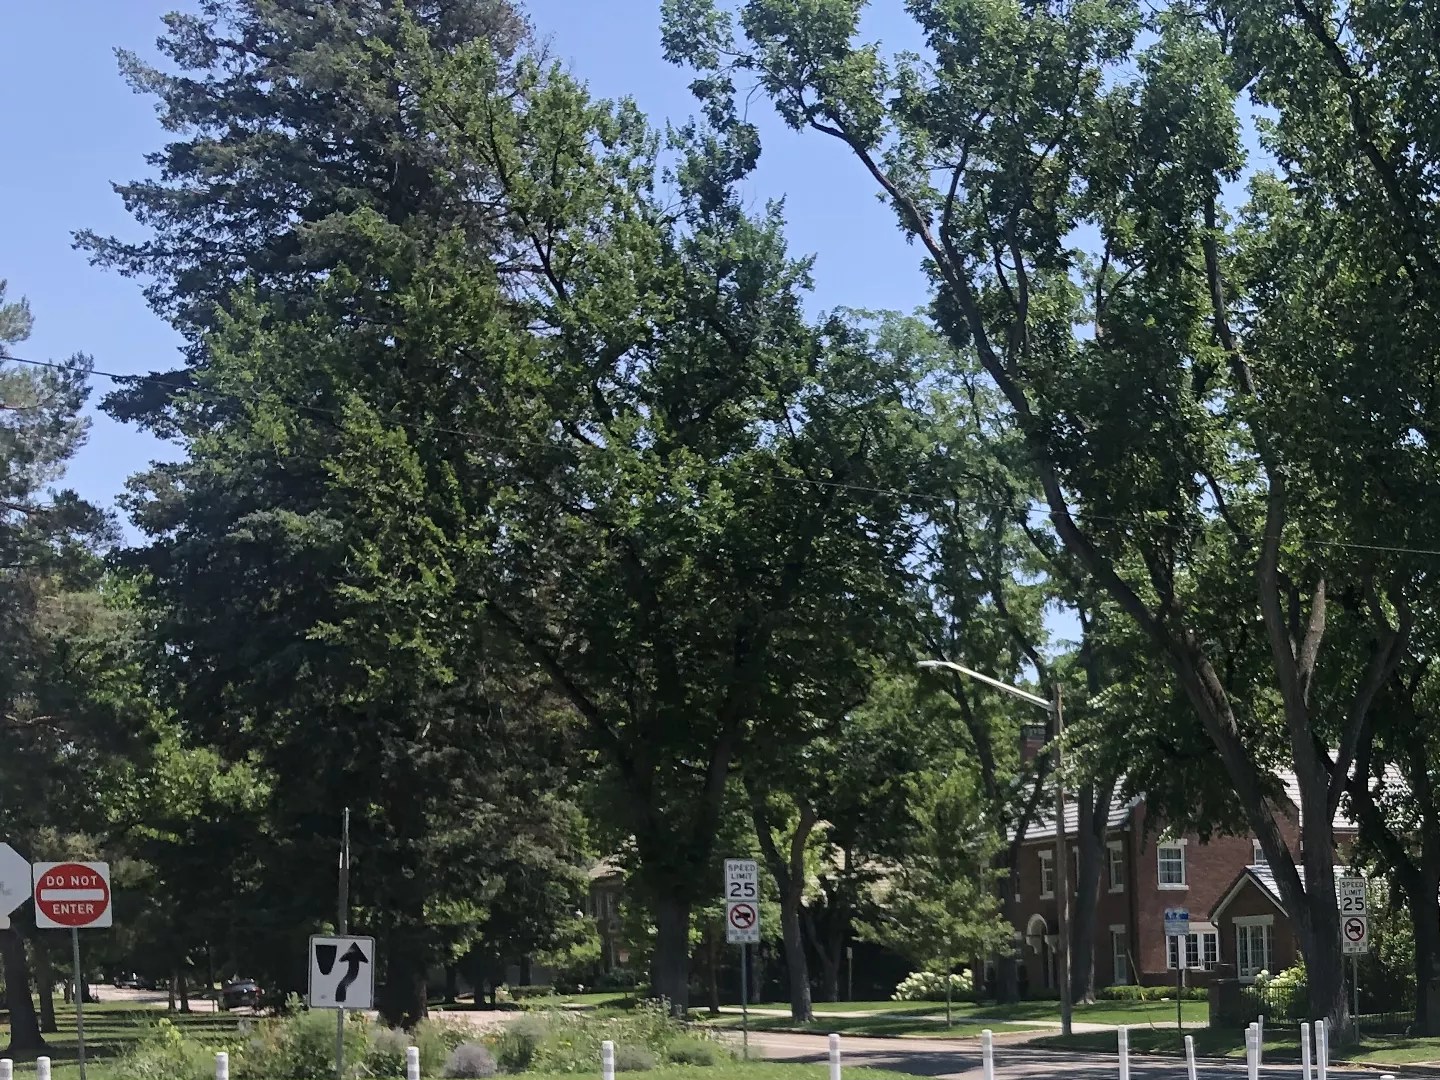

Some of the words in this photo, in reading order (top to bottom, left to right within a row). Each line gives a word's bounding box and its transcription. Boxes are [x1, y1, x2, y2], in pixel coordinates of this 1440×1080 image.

[728, 863, 756, 872] SPEED
[46, 875, 65, 887] DO
[70, 875, 97, 886] NOT
[1341, 881, 1364, 889] SPEED
[730, 882, 756, 898] 25
[52, 903, 95, 915] ENTER
[1343, 897, 1365, 911] 25
